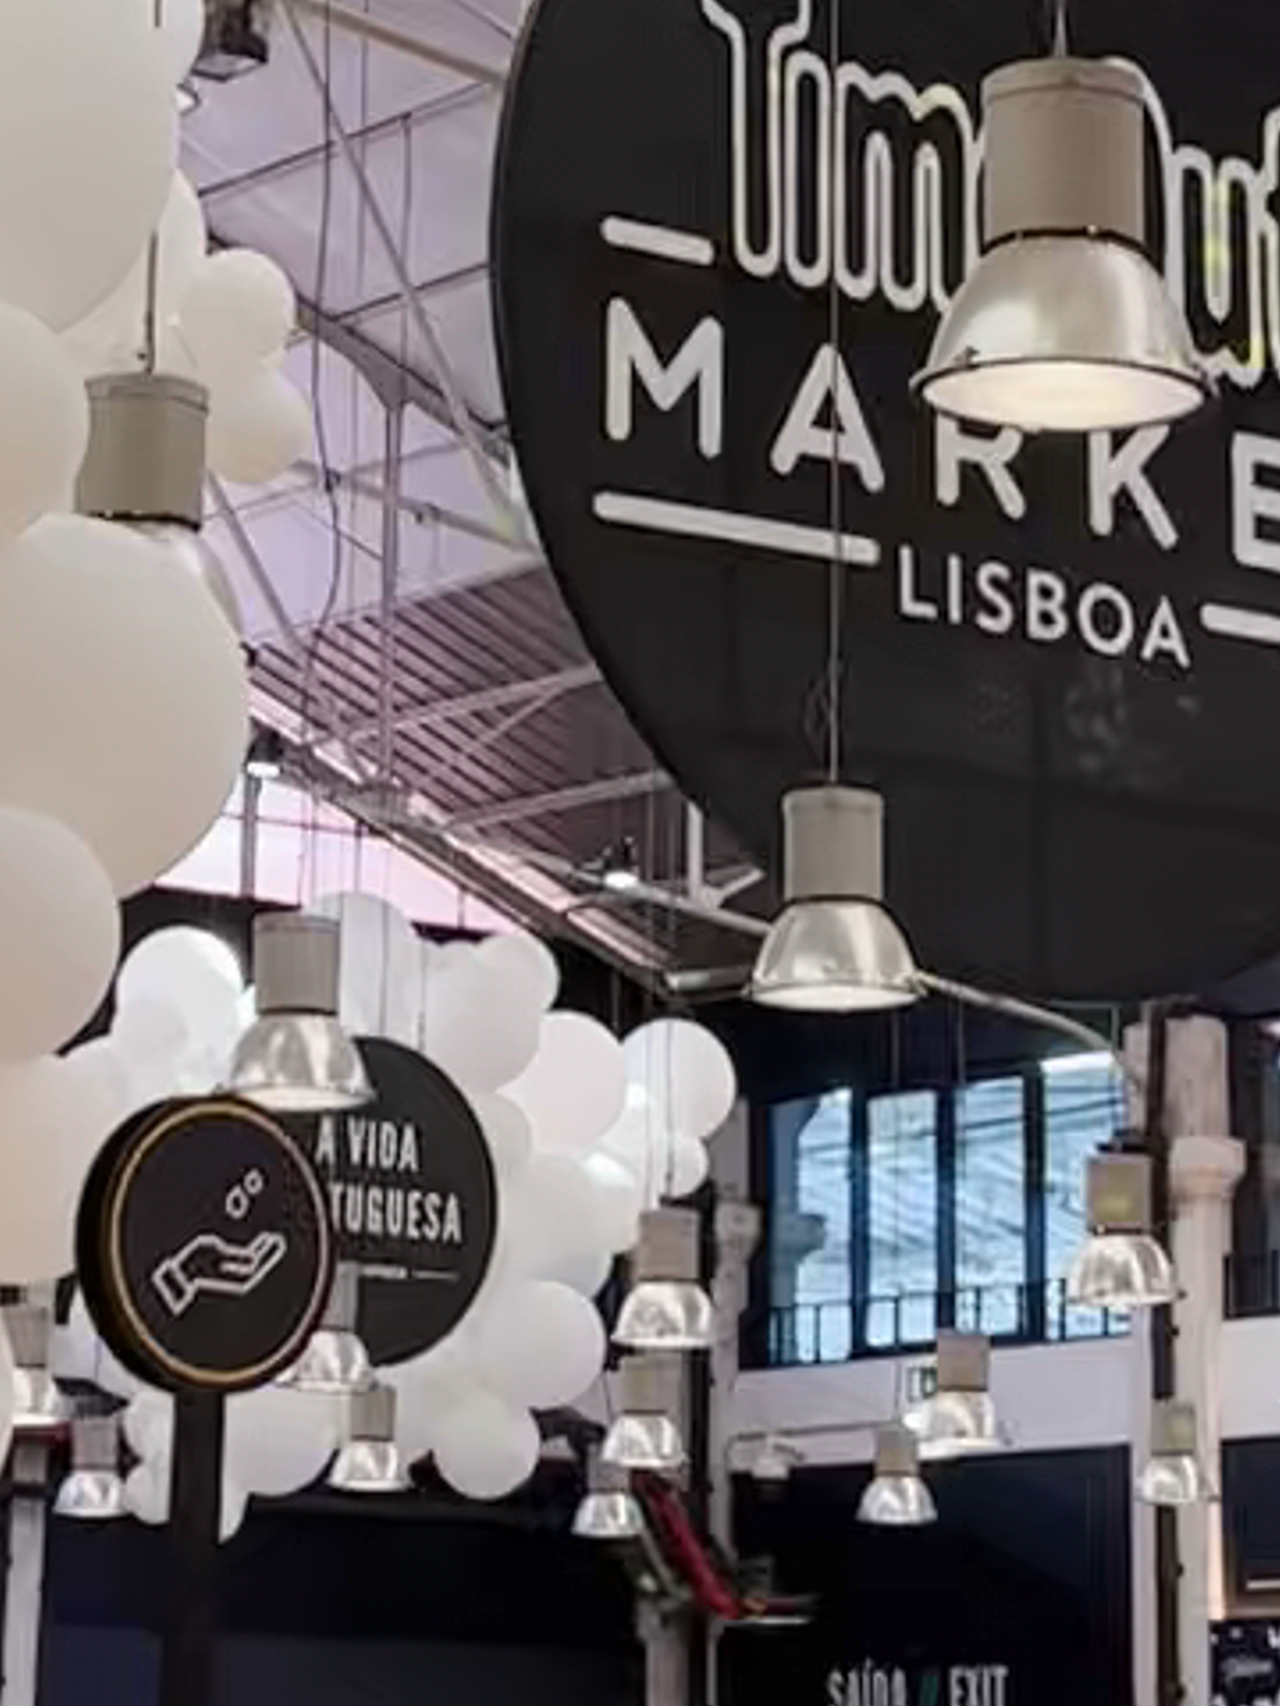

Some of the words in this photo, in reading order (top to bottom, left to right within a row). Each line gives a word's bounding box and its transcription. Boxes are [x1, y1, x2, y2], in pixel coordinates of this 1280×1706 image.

[897, 541, 1191, 670] LISBOA
[315, 1115, 335, 1164] A
[347, 1116, 419, 1172] VIDA
[327, 1181, 463, 1244] TUGUESA
